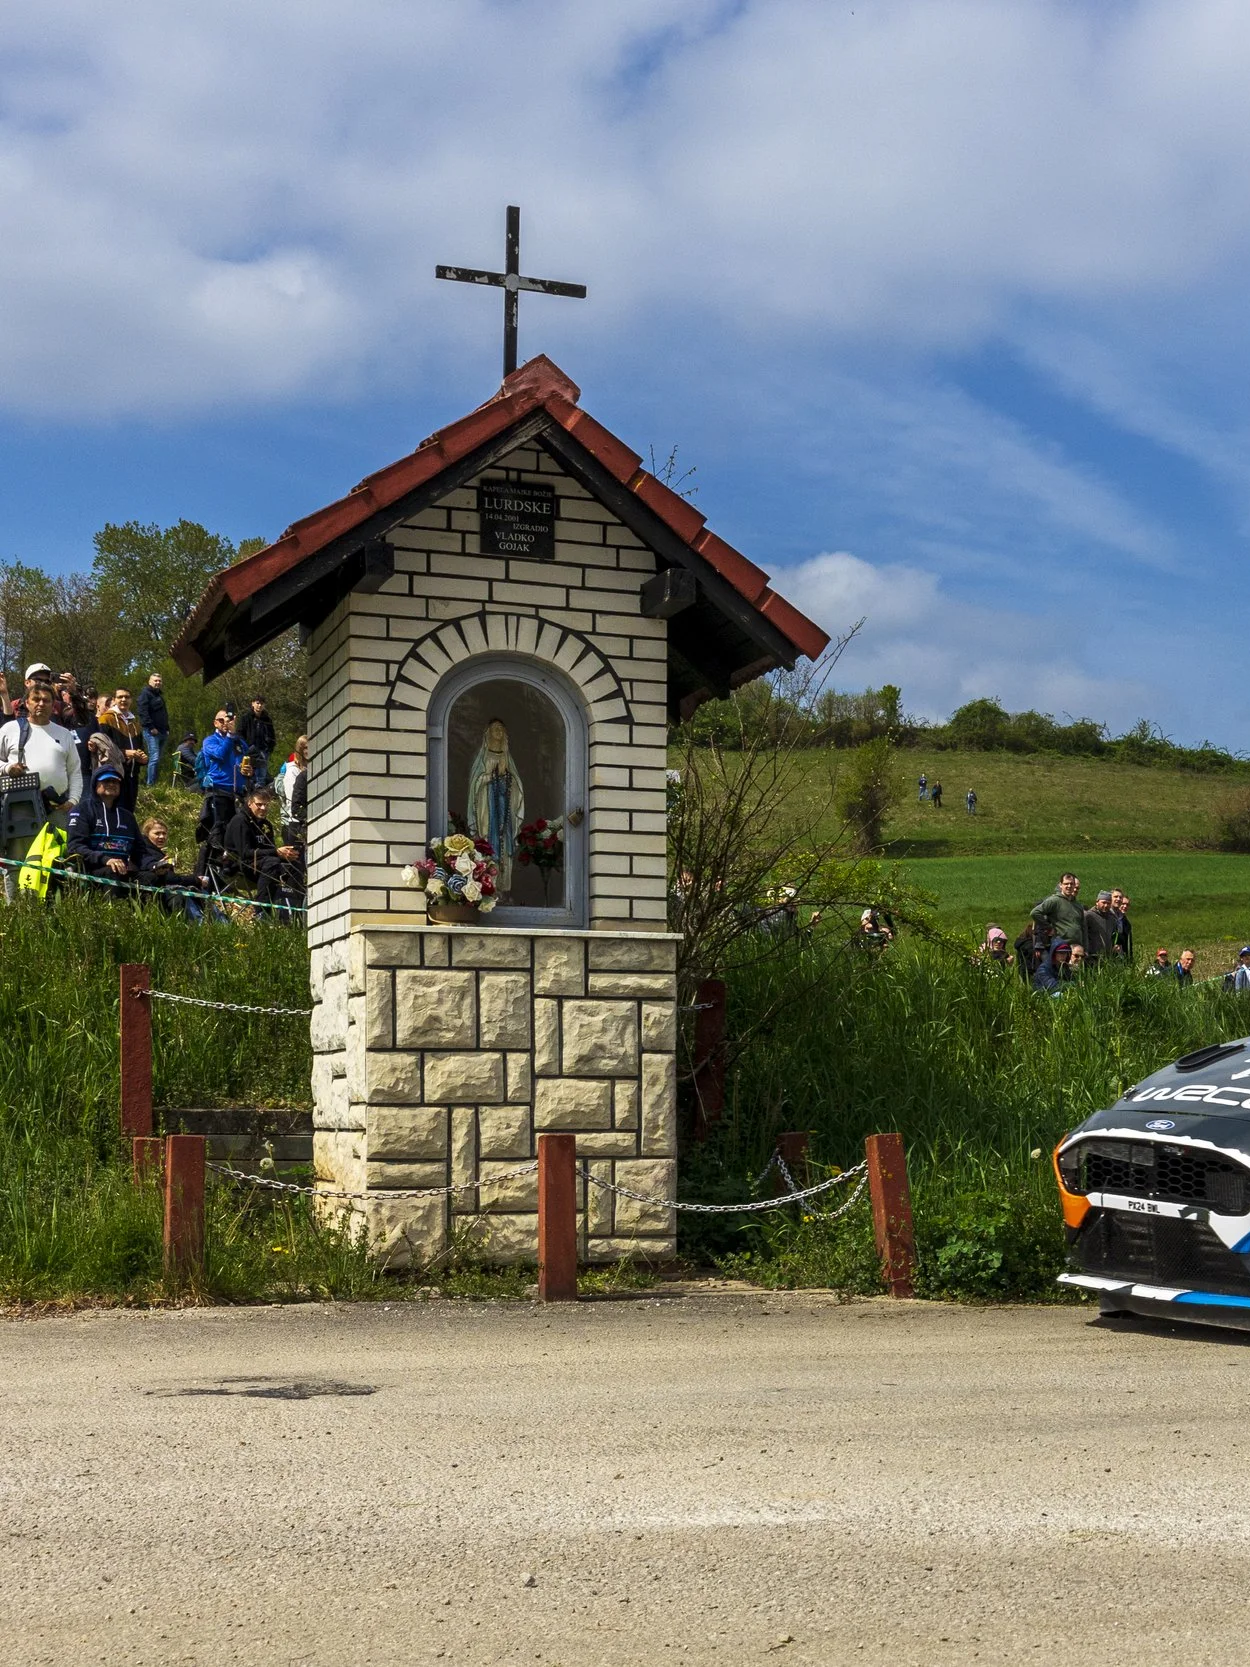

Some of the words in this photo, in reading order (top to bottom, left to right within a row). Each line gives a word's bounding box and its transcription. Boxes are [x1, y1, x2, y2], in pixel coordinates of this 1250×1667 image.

[484, 497, 551, 514] LURDSKE
[513, 523, 548, 533] IZGRADIO
[495, 532, 535, 542] VLADKO
[499, 542, 530, 552] GOJAK
